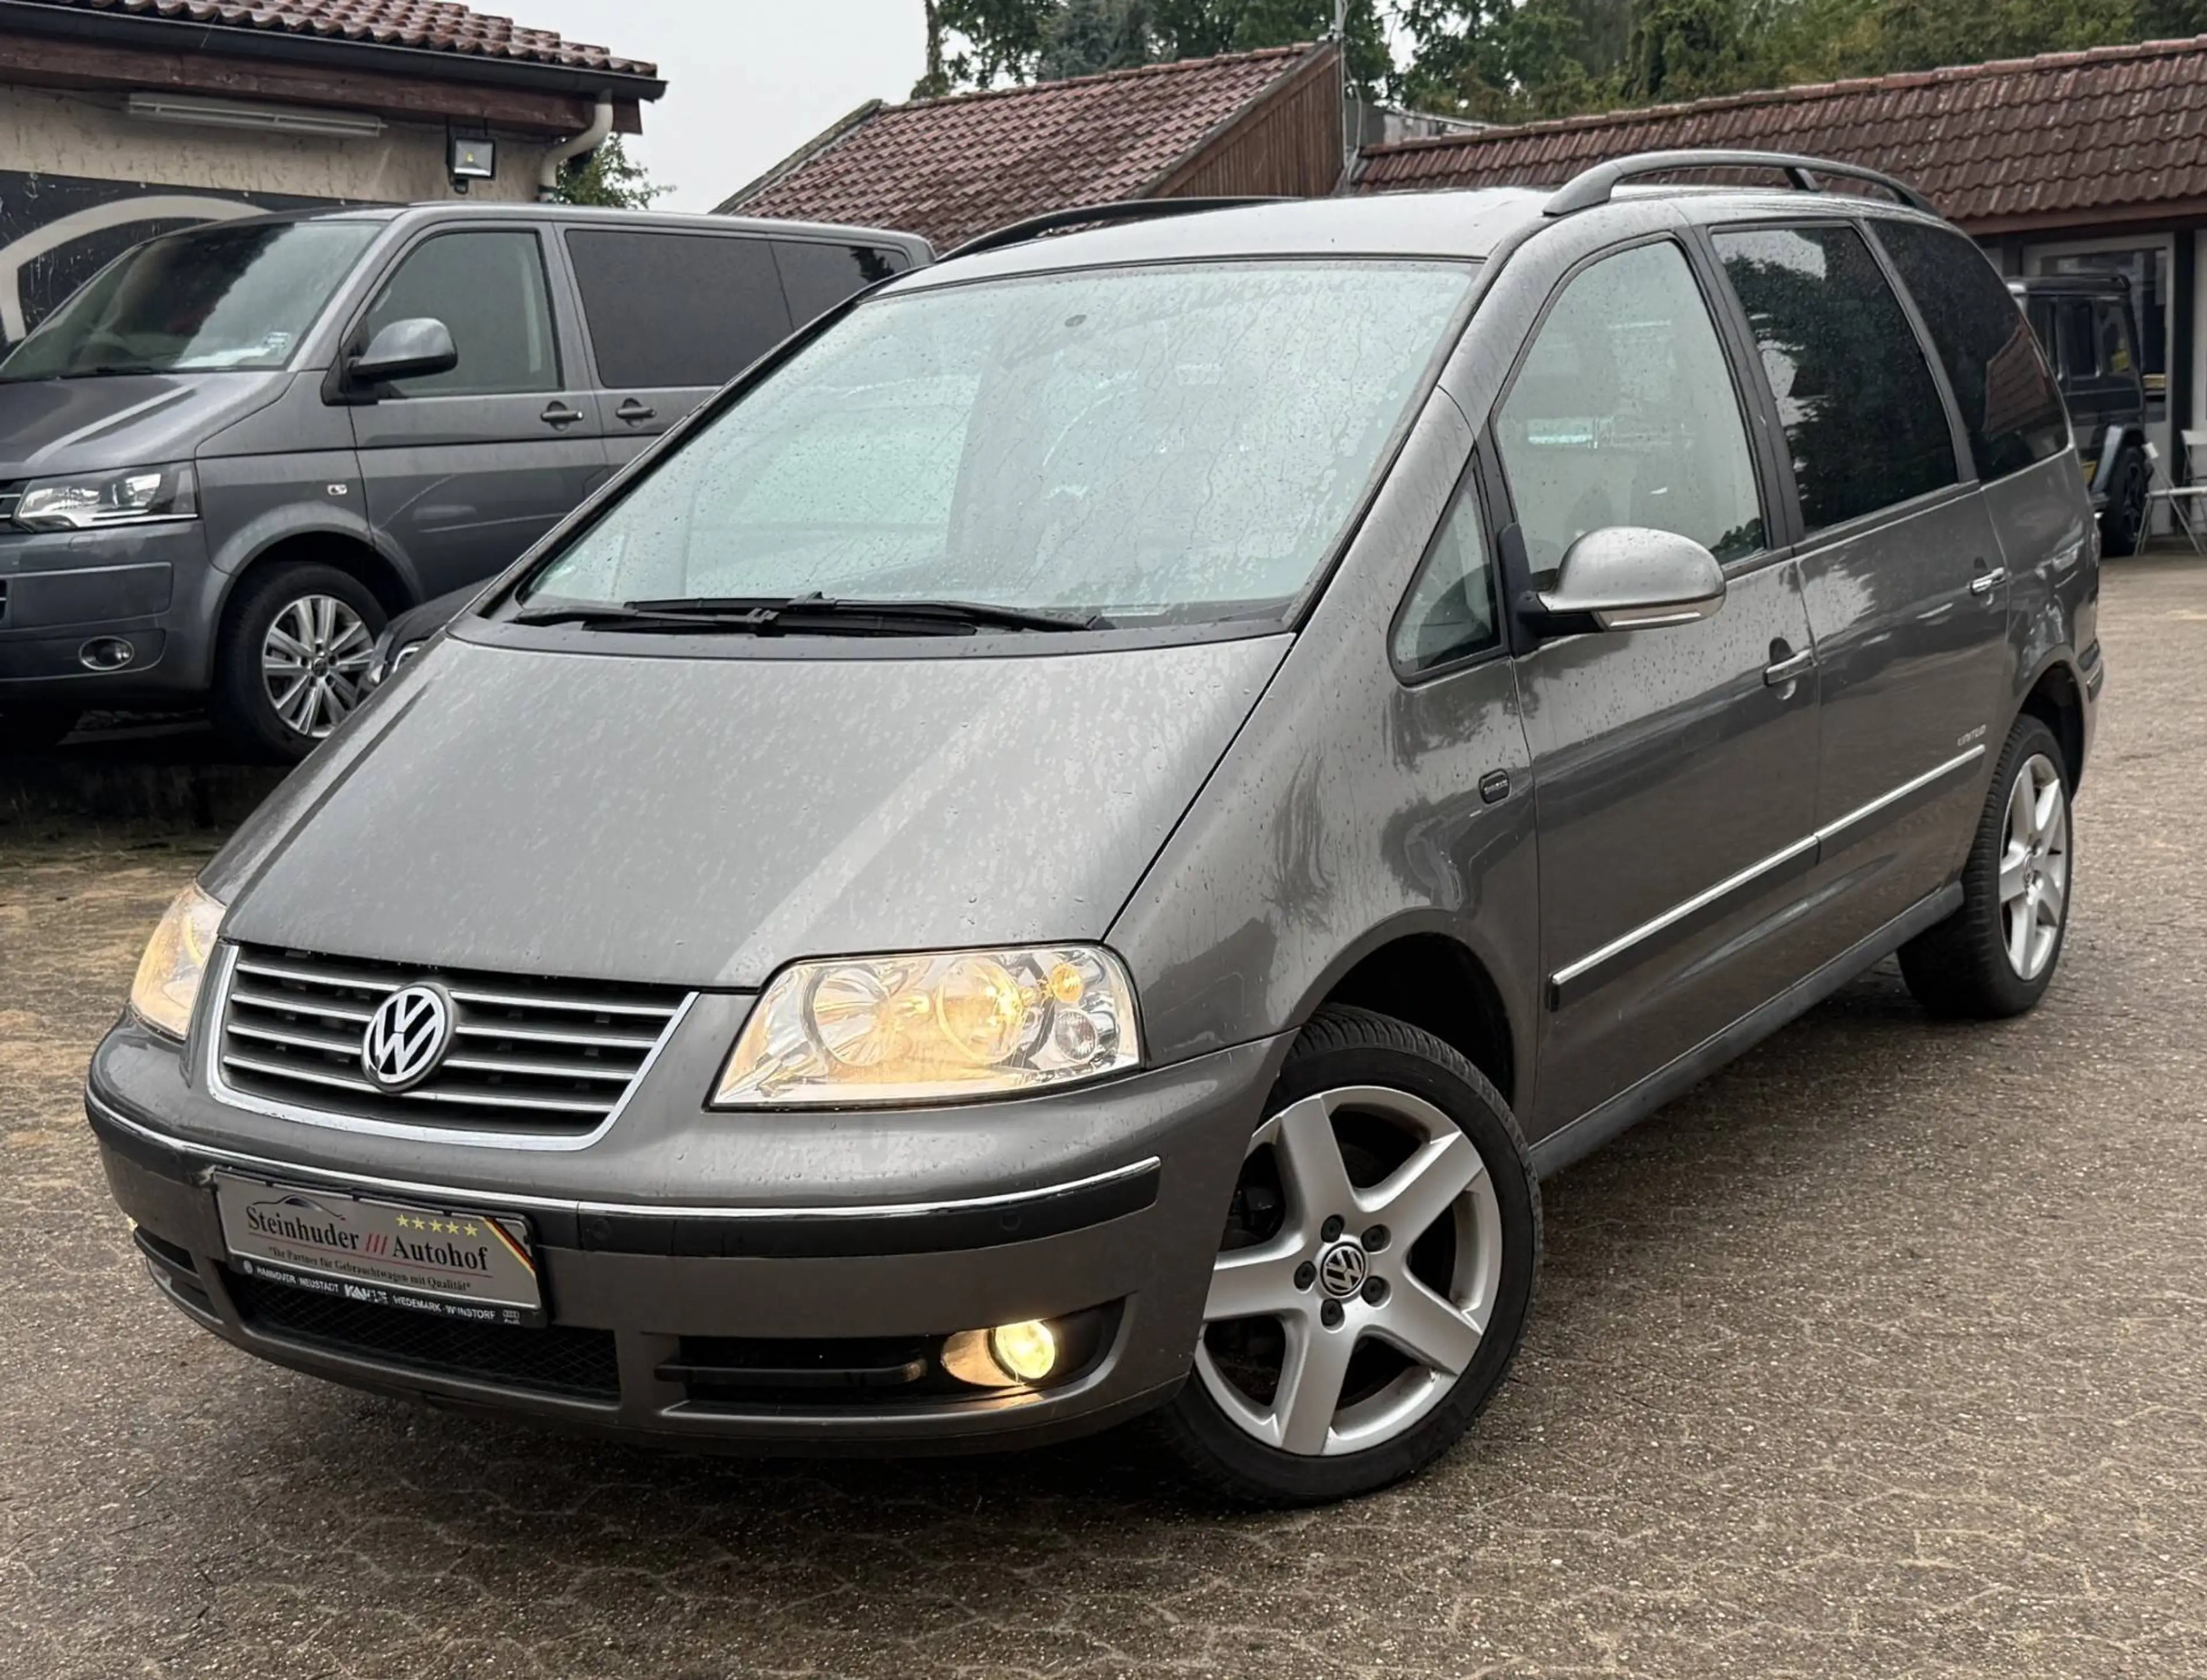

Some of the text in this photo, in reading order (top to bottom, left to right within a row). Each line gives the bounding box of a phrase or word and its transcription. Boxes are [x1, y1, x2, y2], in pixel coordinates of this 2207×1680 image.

[367, 987, 444, 1083] VW
[246, 1206, 359, 1250] Steinhuder
[393, 1234, 488, 1270] Autohof
